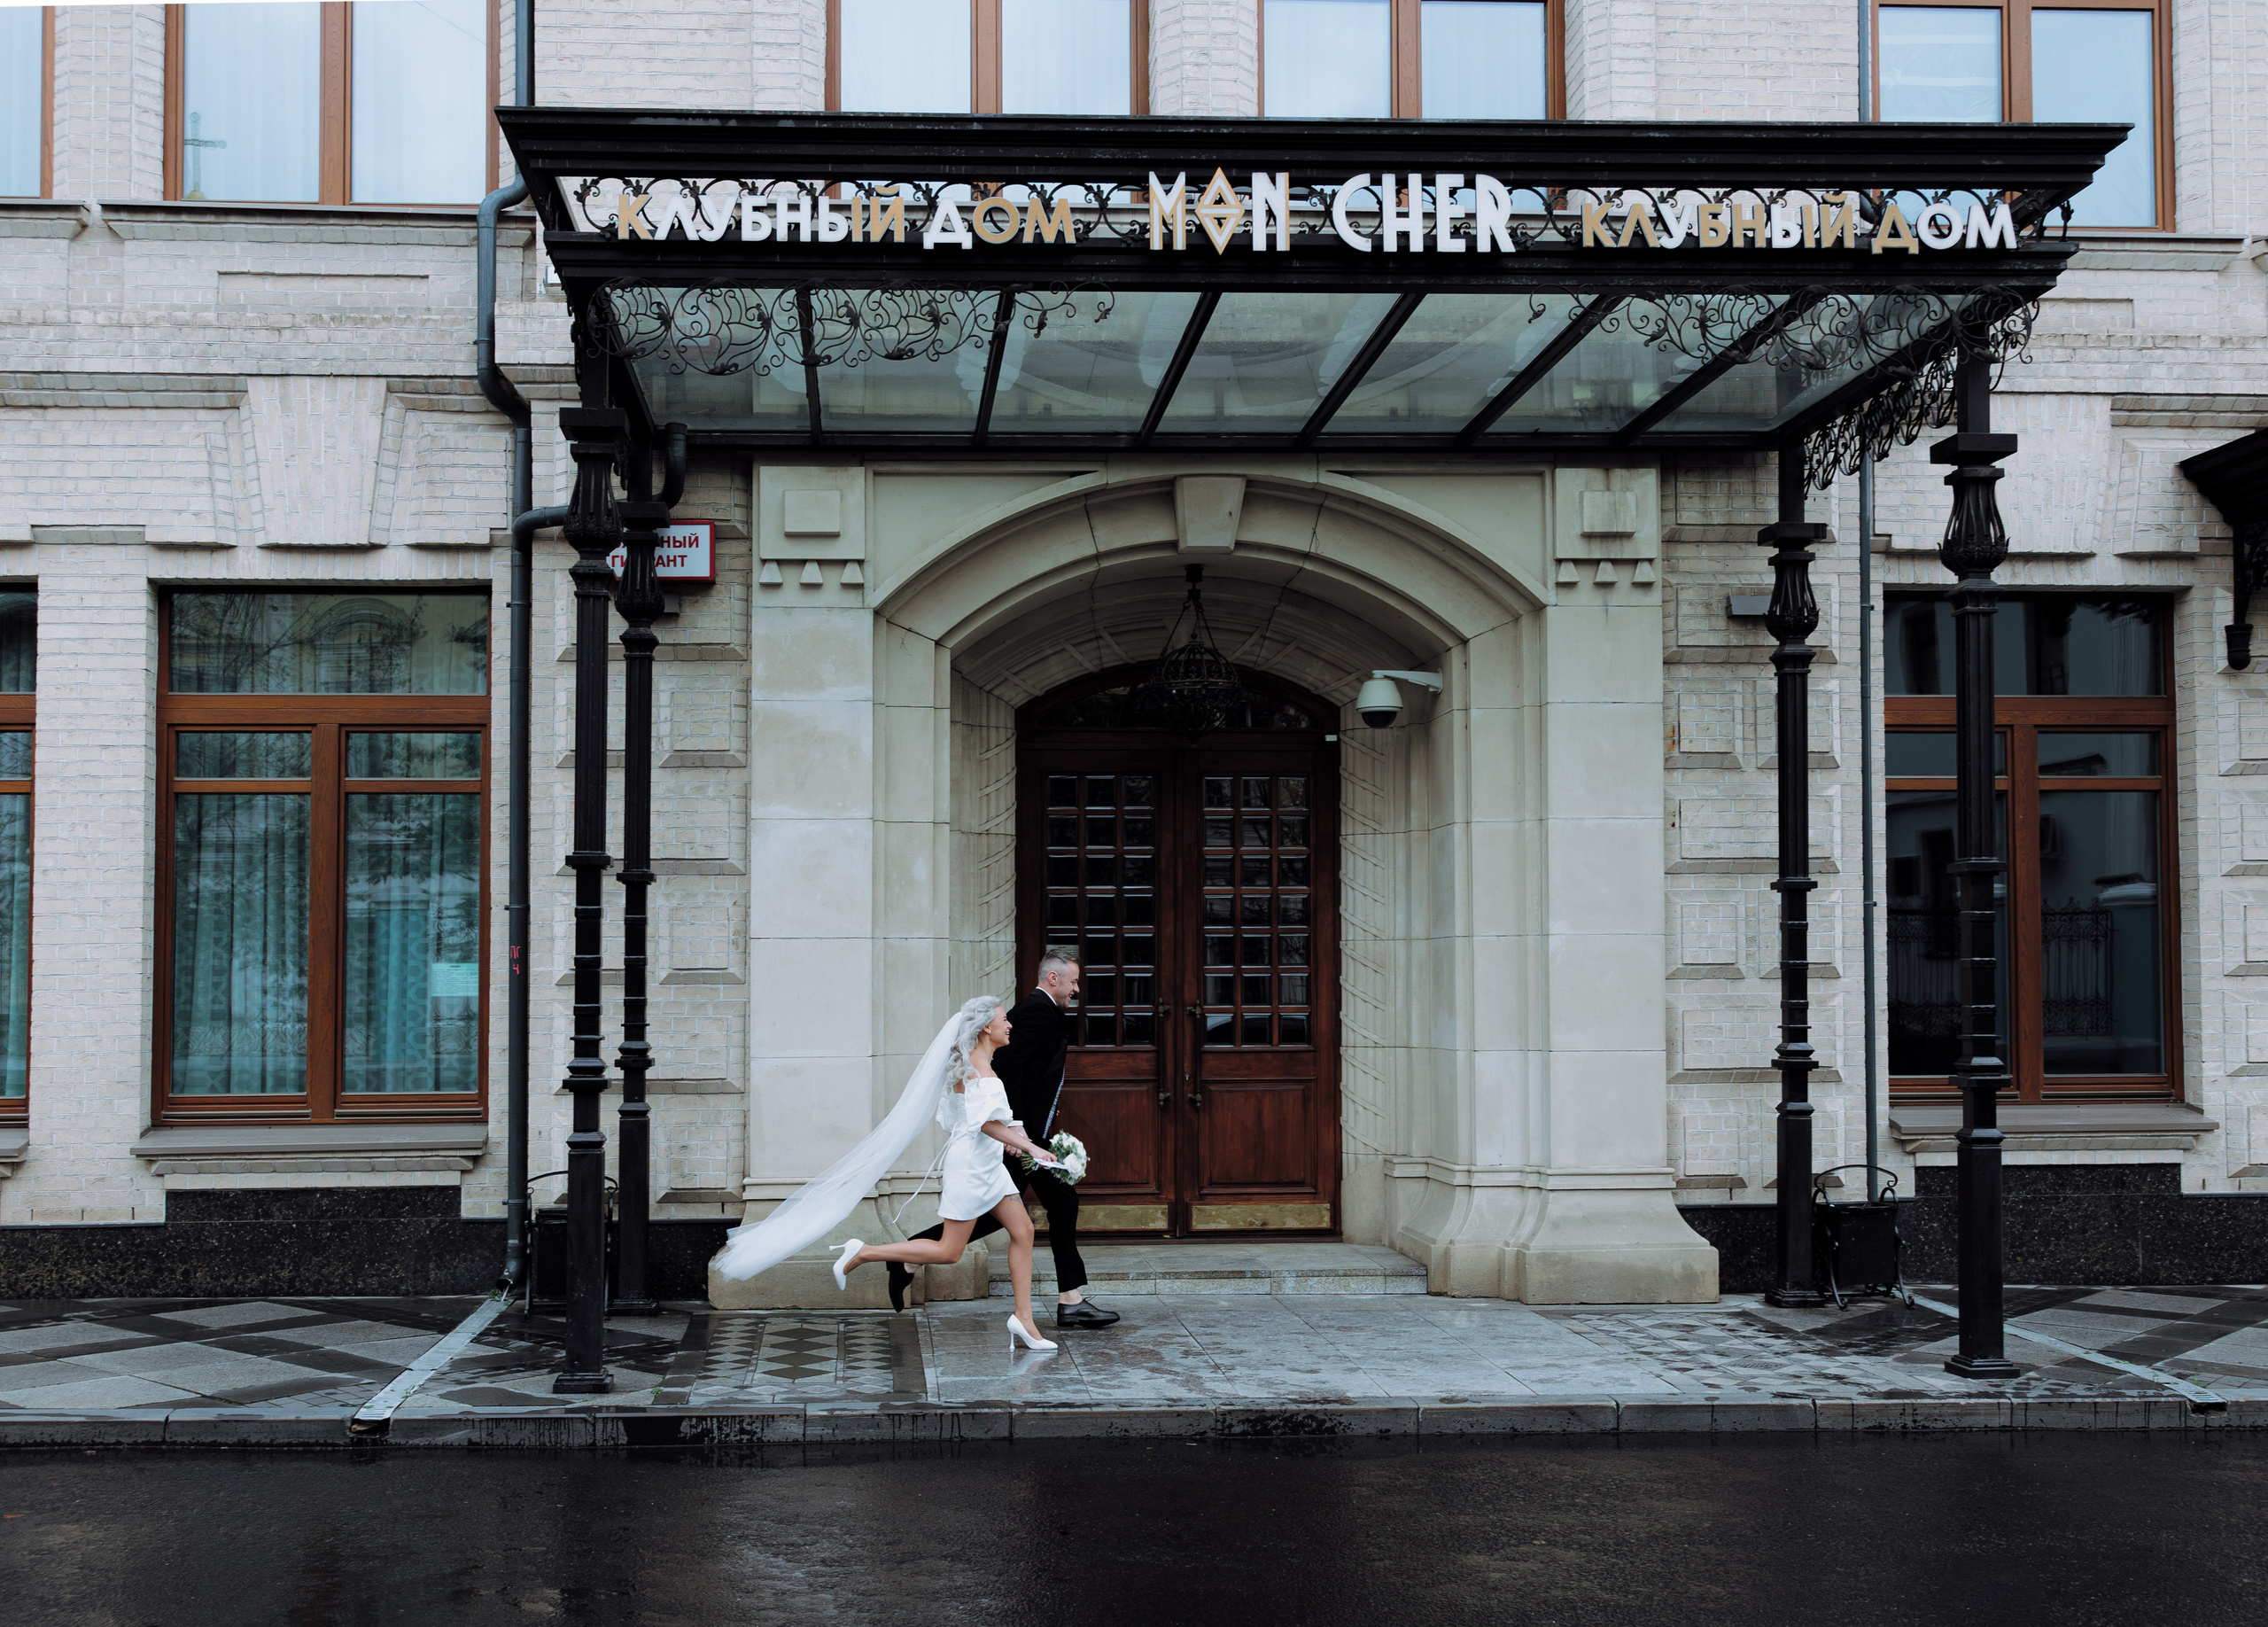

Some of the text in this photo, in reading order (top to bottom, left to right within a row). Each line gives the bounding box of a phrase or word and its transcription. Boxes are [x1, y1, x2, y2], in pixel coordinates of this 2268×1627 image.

[617, 184, 1077, 250] КЛУБНЫЙ ДОМ
[1332, 173, 1517, 253] CHER
[1581, 192, 2018, 255] КЛУБНЫЙ ДОМ
